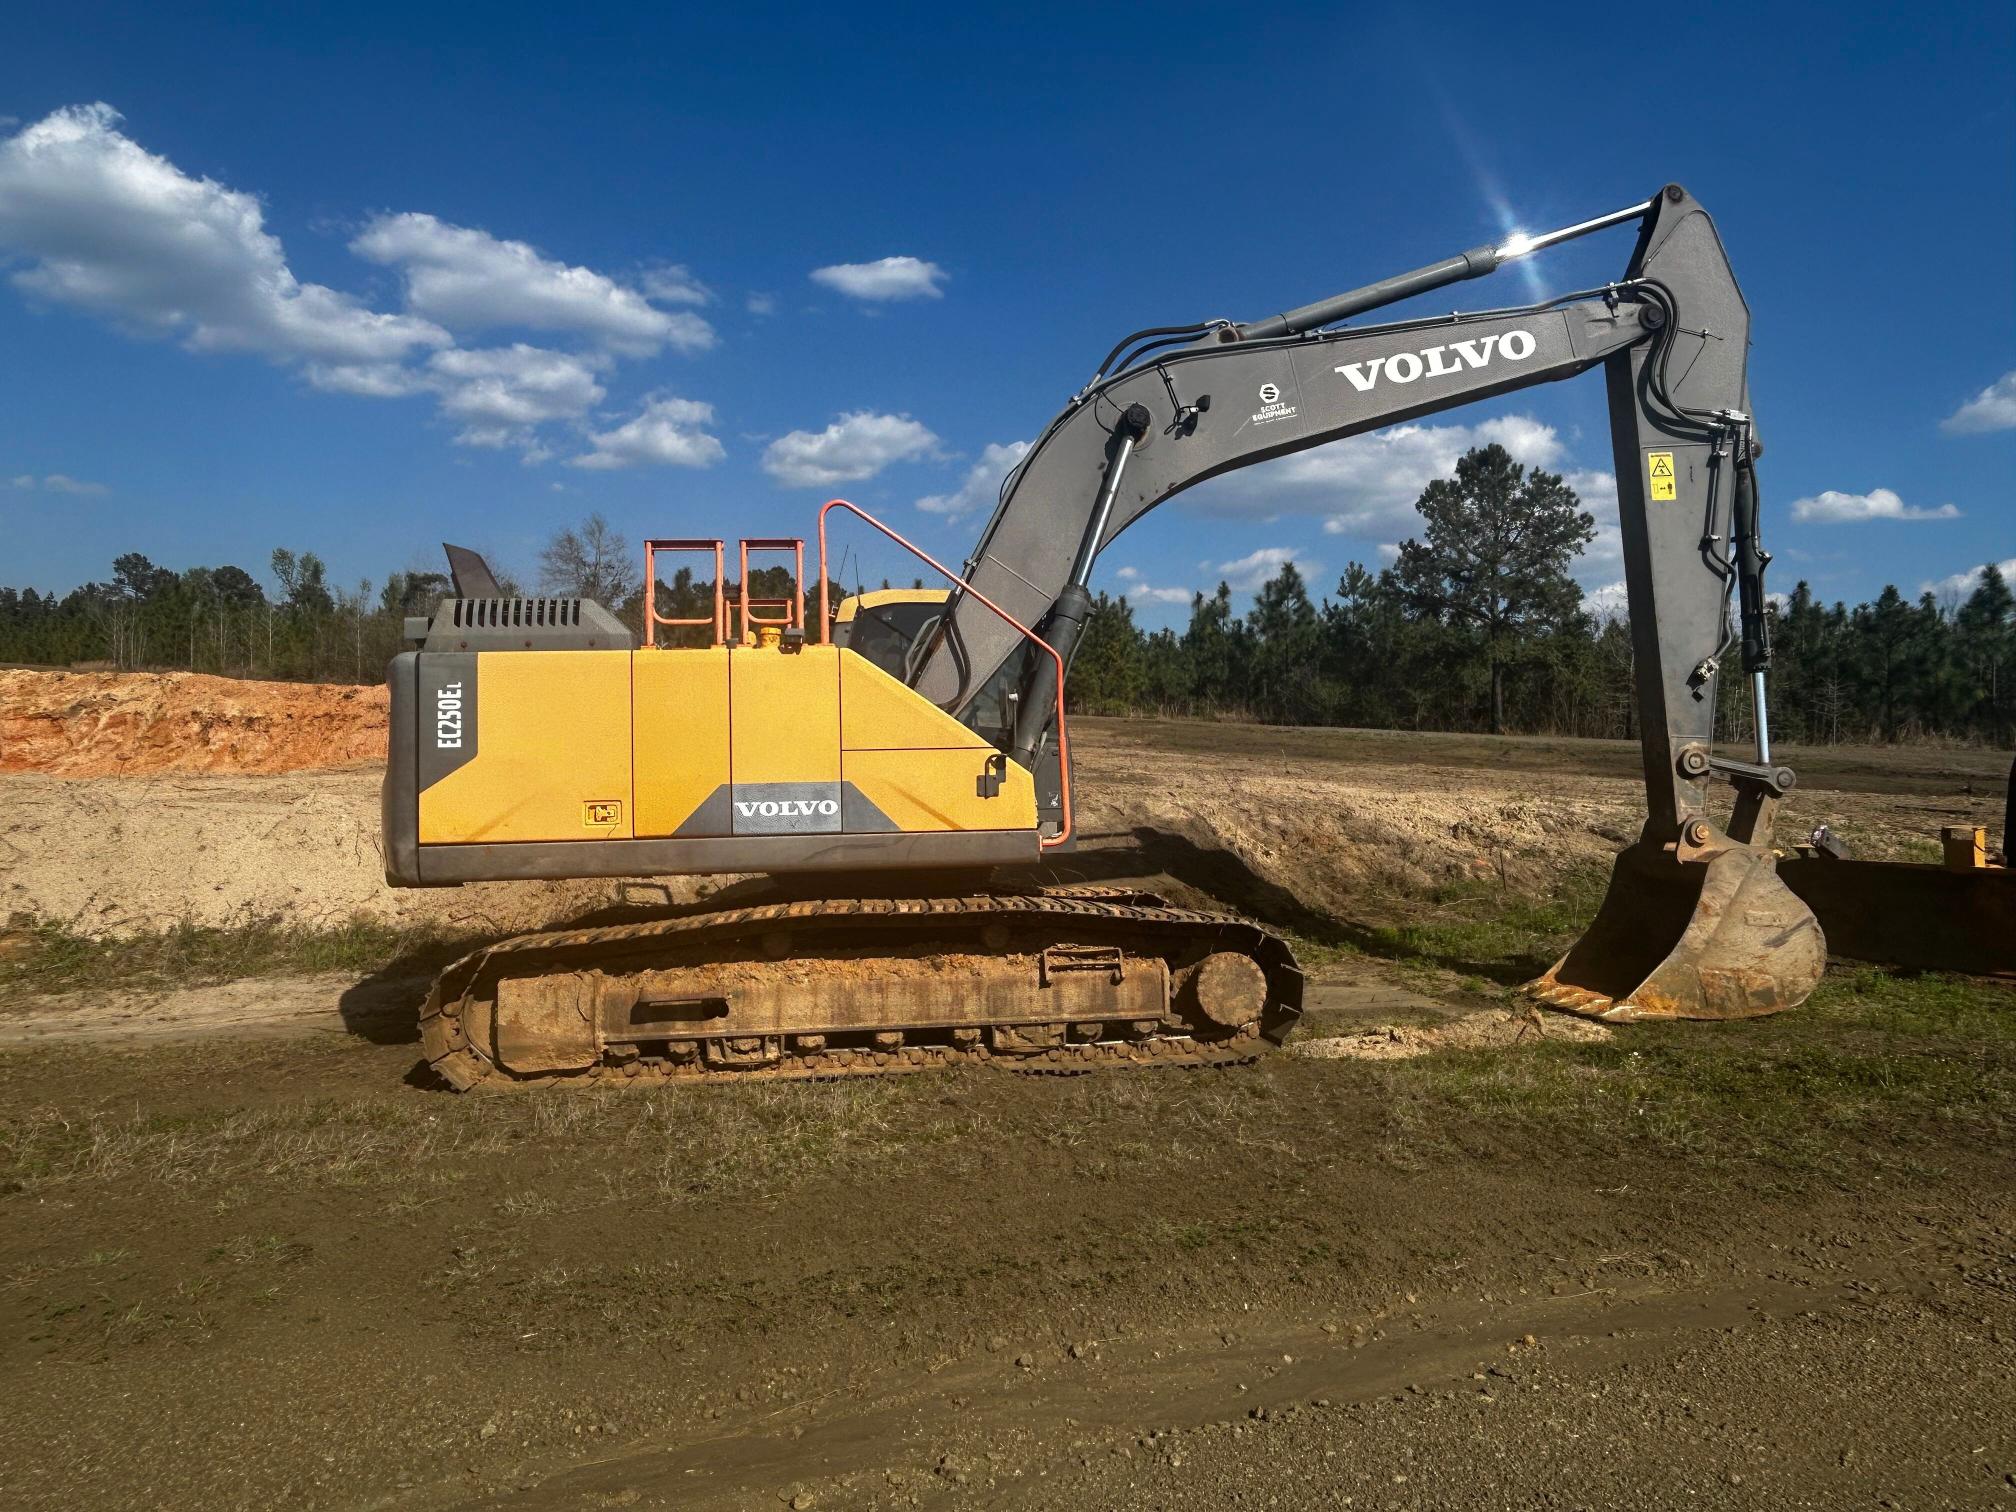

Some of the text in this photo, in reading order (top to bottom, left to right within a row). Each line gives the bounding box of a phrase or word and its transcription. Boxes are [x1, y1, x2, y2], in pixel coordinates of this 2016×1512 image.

[1334, 330, 1537, 392] VOLVO
[1252, 407, 1296, 421] EQUIPMENT
[1260, 402, 1285, 413] SCOTT
[734, 799, 839, 817] VOLVO
